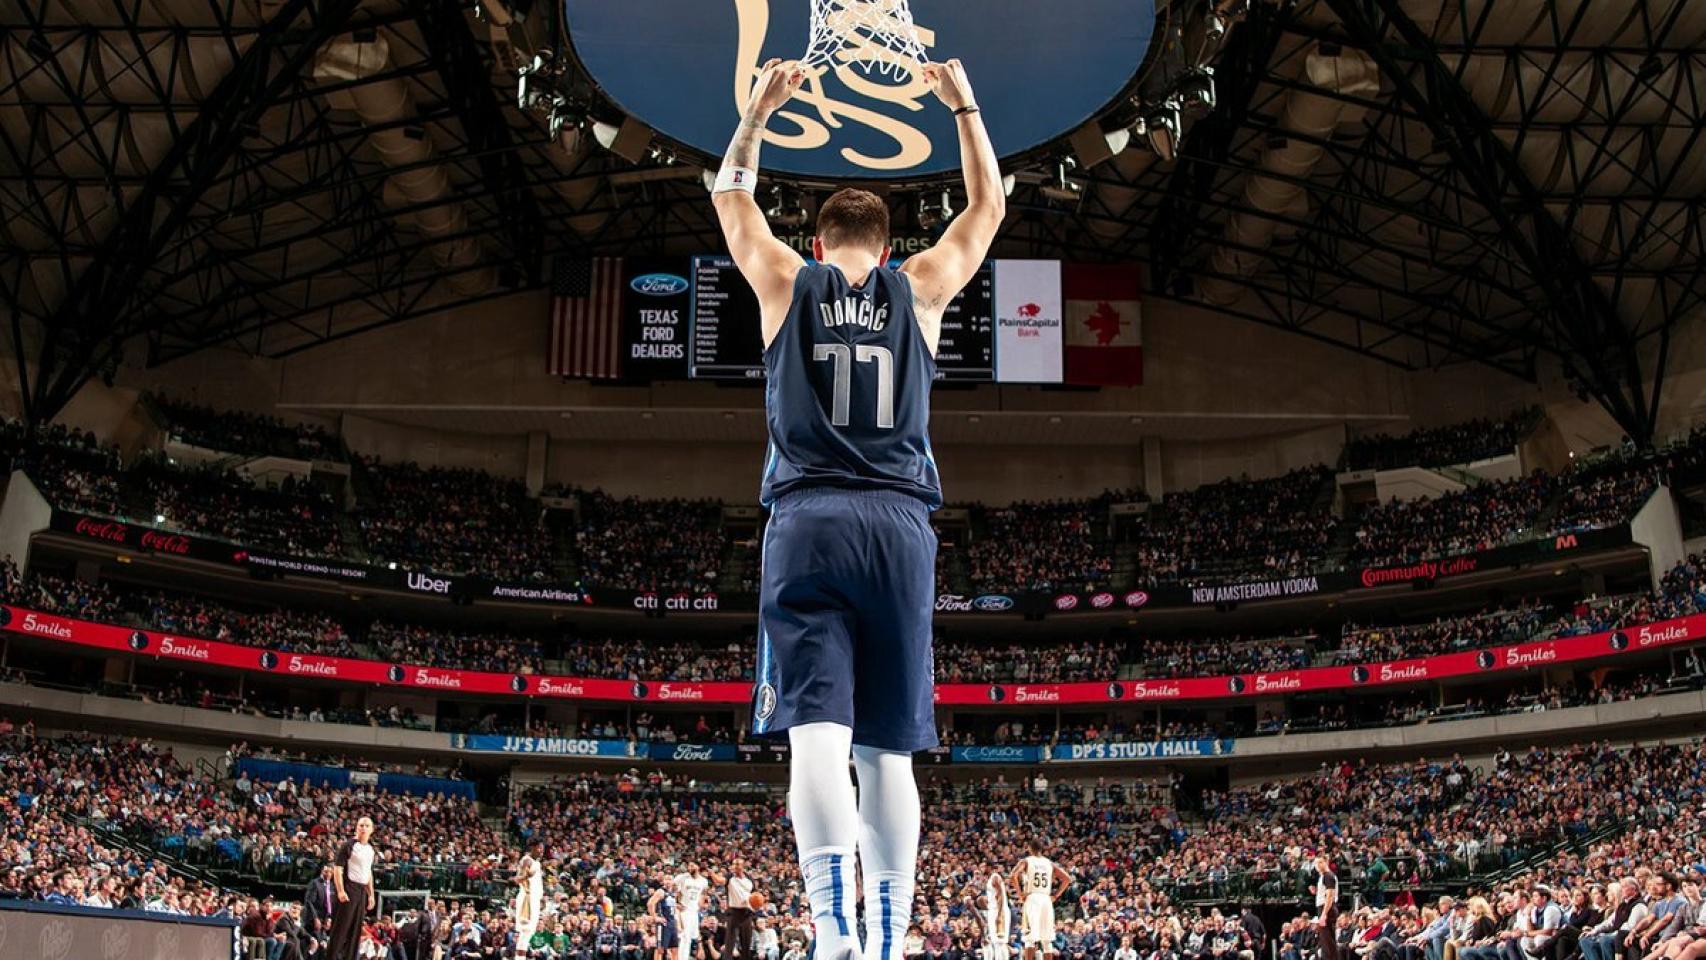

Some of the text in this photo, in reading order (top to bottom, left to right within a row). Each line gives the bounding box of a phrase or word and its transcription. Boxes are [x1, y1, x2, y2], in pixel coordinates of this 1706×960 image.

[639, 309, 679, 324] TEXAS
[820, 293, 888, 331] DONČIĆ
[998, 318, 1059, 328] PlainsCapital
[643, 326, 675, 341] FORD
[1018, 328, 1040, 337] Bank
[632, 343, 684, 358] DEALERS
[813, 343, 894, 428] 77
[279, 560, 302, 570] WORLD
[342, 568, 367, 577] RESORT
[1362, 560, 1437, 587] Community
[407, 572, 451, 593] Uber
[1193, 577, 1318, 603] NEW AMSTERDAM VODKA
[493, 586, 578, 601] American Airlines
[634, 594, 718, 609] citi citi citi
[935, 594, 973, 611] Ford
[981, 597, 1006, 609] Ford
[23, 614, 72, 638] 5miles
[1640, 627, 1688, 646] 5miles
[160, 637, 208, 659] 5miles
[1507, 648, 1556, 665] 5miles
[289, 655, 337, 675] 5miles
[1381, 665, 1427, 681] 5miles
[415, 669, 461, 687] 5miles
[1256, 677, 1300, 692] 5miles
[538, 679, 583, 695] 5miles
[658, 684, 702, 699] 5miles
[1016, 687, 1059, 701] 5miles
[1135, 682, 1180, 698] 5miles
[502, 737, 599, 754] JJ'S AMIGOS
[672, 743, 712, 760] Ford
[1072, 740, 1200, 759] DP'S STUDY HALL
[1033, 871, 1049, 888] 55
